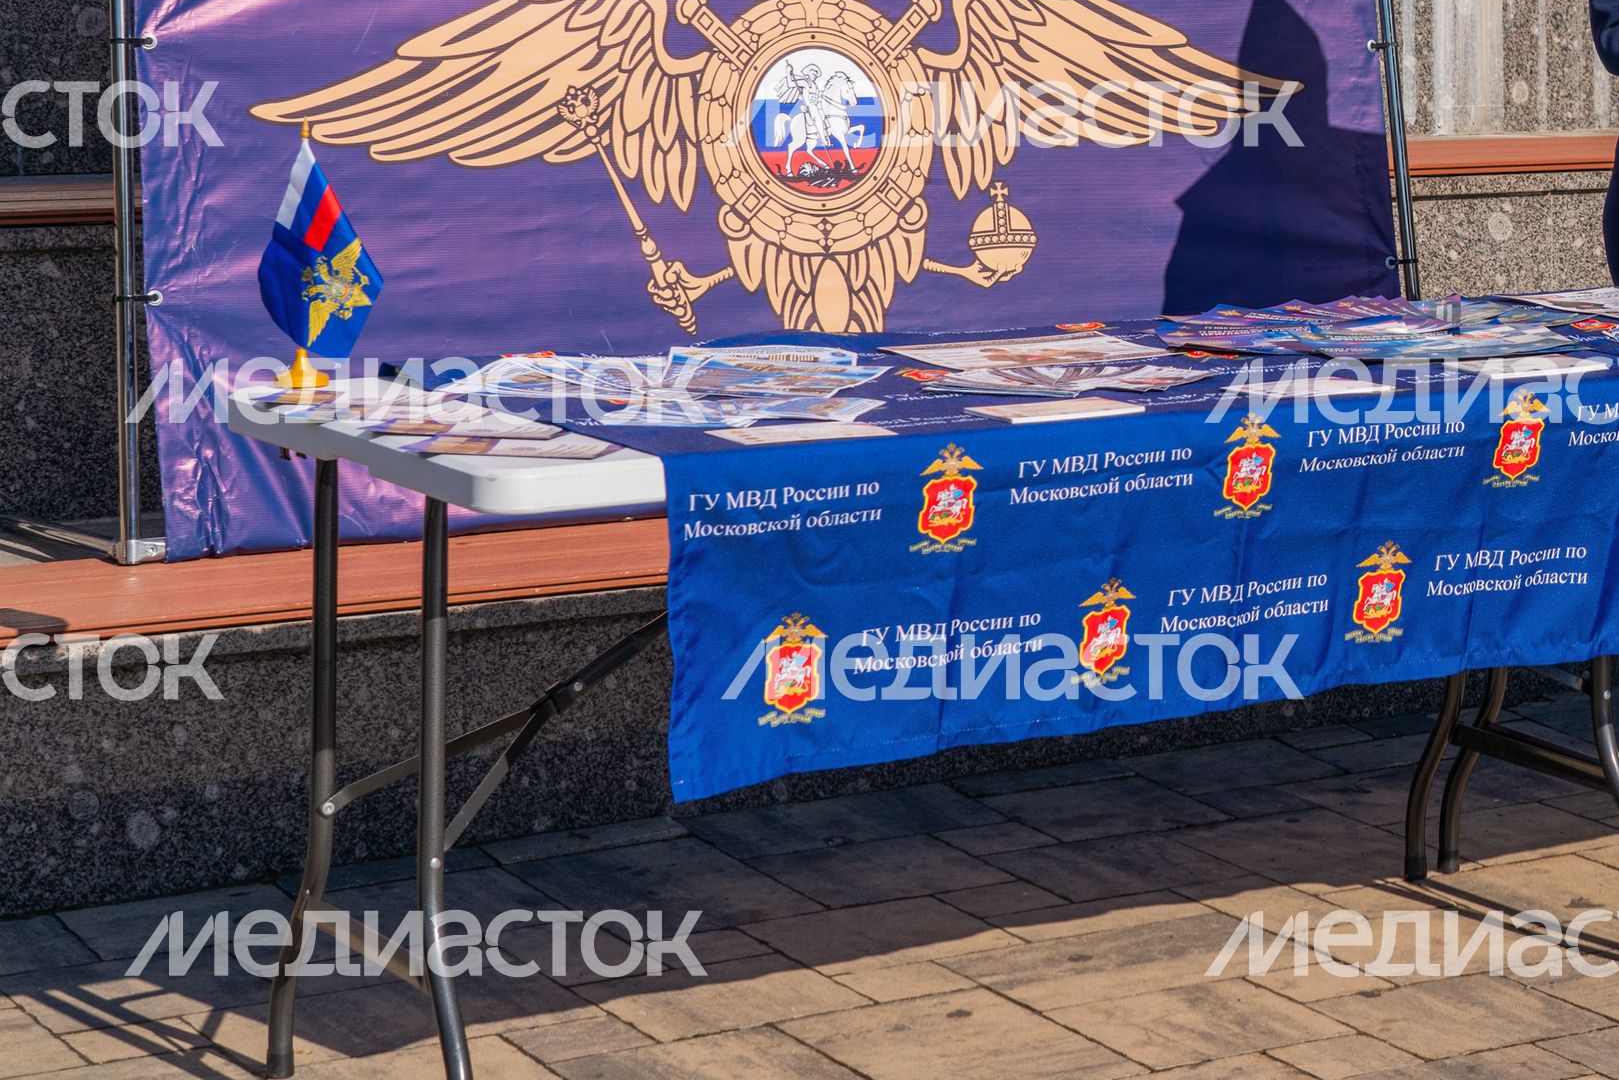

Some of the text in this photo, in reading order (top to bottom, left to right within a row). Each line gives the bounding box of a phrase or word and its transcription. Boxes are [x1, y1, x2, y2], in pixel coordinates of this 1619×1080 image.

[1577, 404, 1600, 421] ГУ
[1308, 420, 1465, 448] ГУ МВД России по
[1018, 447, 1192, 478] ГУ МВД России по
[1299, 445, 1465, 473] Московской области
[689, 481, 880, 511] ГУ МВД России по
[1009, 473, 1193, 505] Московской области
[684, 508, 882, 541] Московской области
[1434, 546, 1587, 572] ГУ МВД России по
[1167, 574, 1328, 607] ГУ МВД России по
[1426, 569, 1588, 597] Московской области
[861, 613, 1041, 647] ГУ МВД России по
[1160, 599, 1329, 634] Московской области
[853, 639, 1043, 675] Московской области
